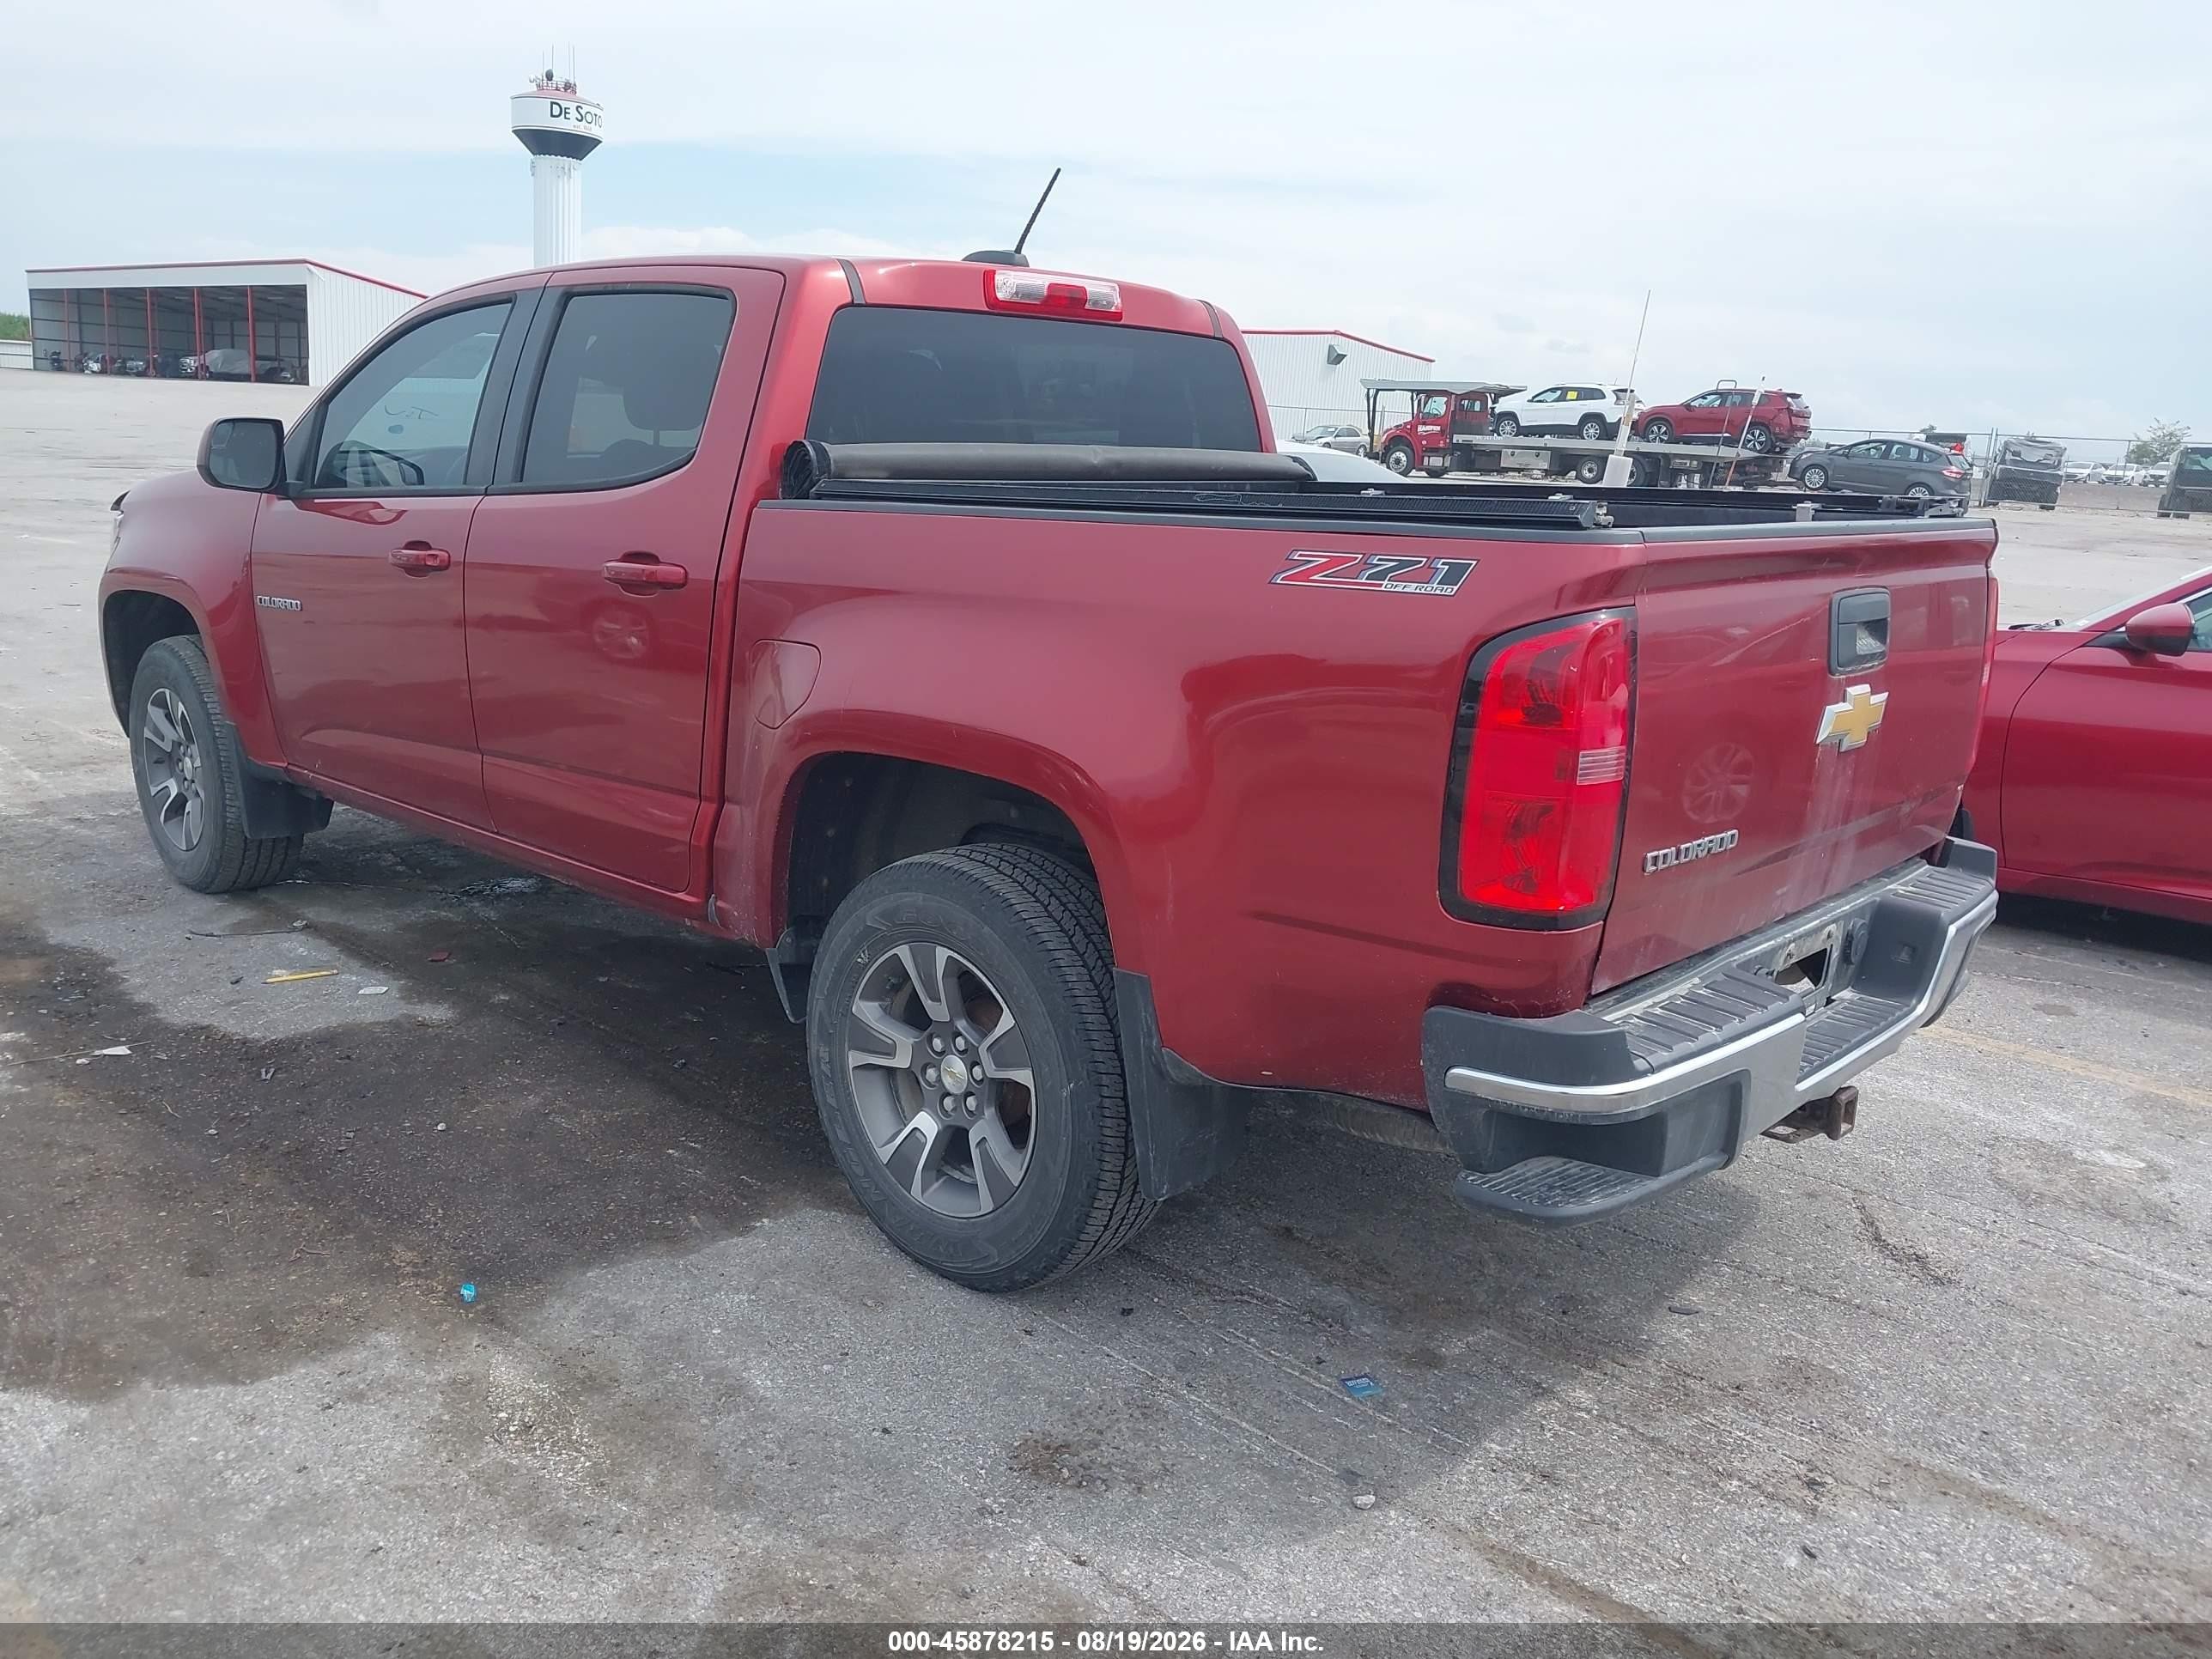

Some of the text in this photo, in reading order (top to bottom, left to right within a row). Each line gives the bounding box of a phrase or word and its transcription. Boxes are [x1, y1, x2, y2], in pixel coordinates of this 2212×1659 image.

[1268, 548, 1480, 587] Z71
[1383, 582, 1455, 594] OFF ROAD
[256, 594, 302, 611] COLORADO
[1644, 829, 1739, 874] COLORADO
